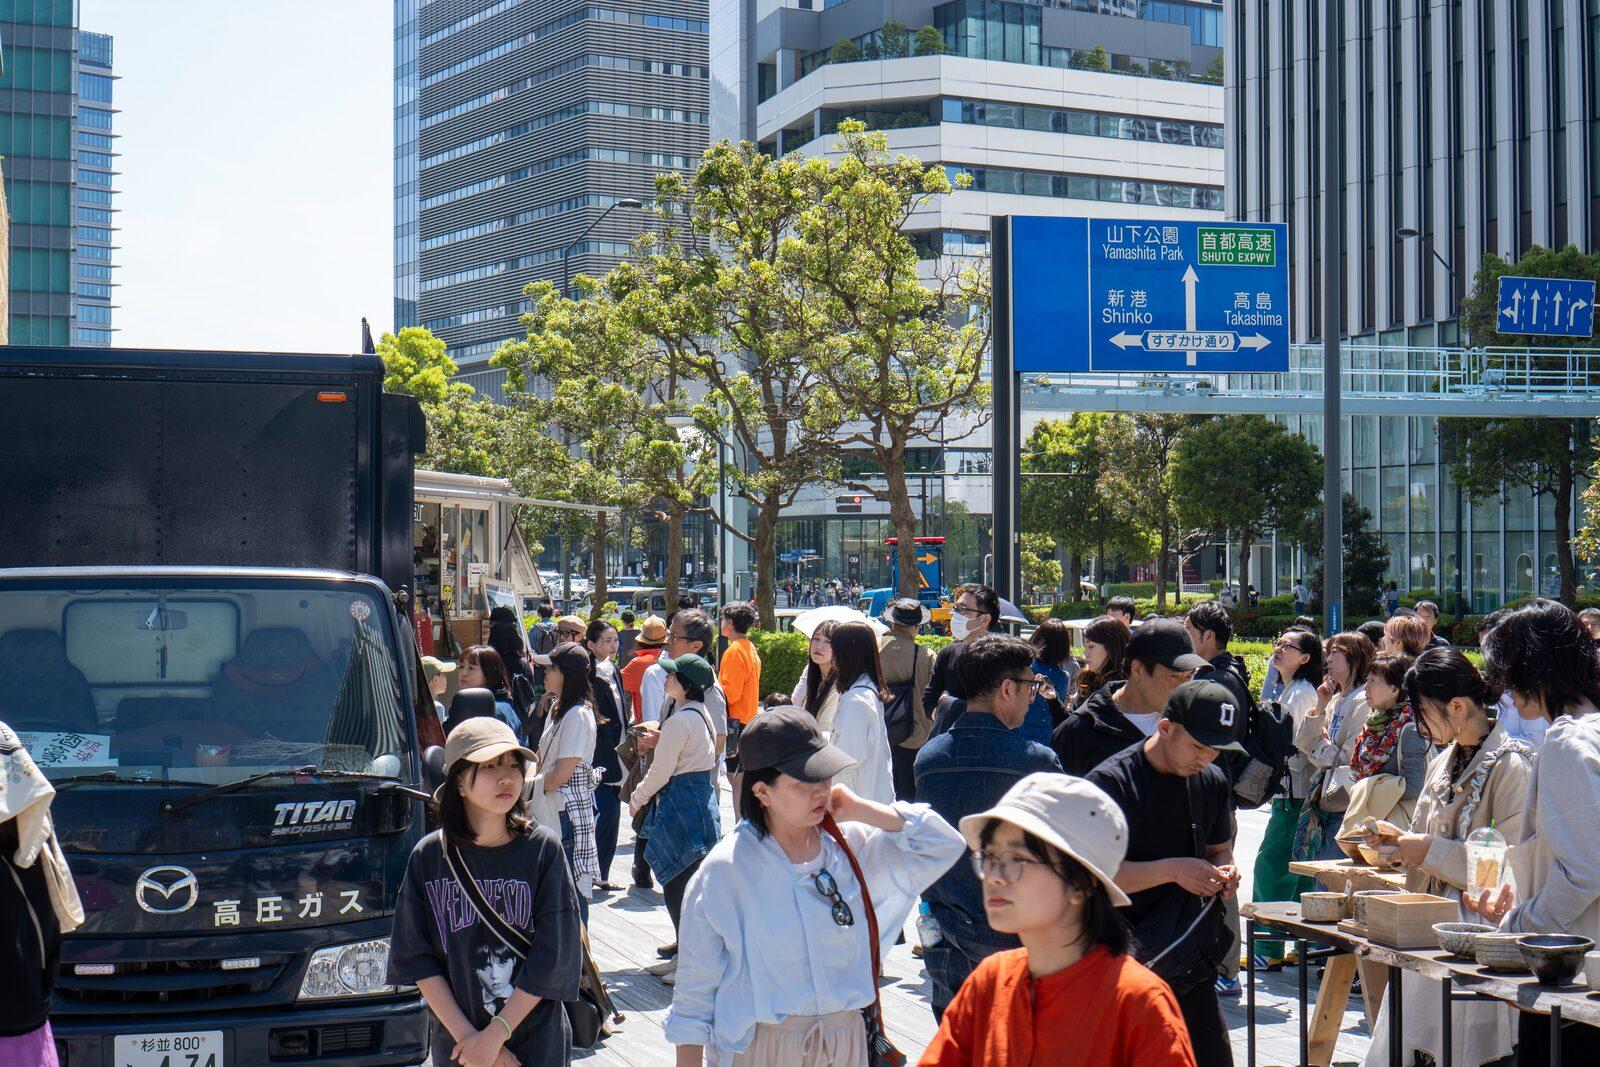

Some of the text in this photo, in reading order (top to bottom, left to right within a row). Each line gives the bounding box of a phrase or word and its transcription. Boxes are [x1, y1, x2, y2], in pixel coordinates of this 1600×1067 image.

[1107, 225, 1179, 244] 山下公園
[1201, 232, 1272, 251] 首都高速
[1102, 243, 1185, 260] Yamashita Park
[1202, 251, 1270, 263] SHUTO EXPWY
[1108, 288, 1147, 308] 新港
[1234, 291, 1272, 310] 高島
[1102, 308, 1153, 324] Shinko
[1224, 310, 1283, 326] Takashima
[1152, 334, 1229, 348] すずかけ通り
[274, 800, 356, 826] TITAN
[213, 890, 364, 927] 高圧ガス
[174, 1037, 200, 1050] 800
